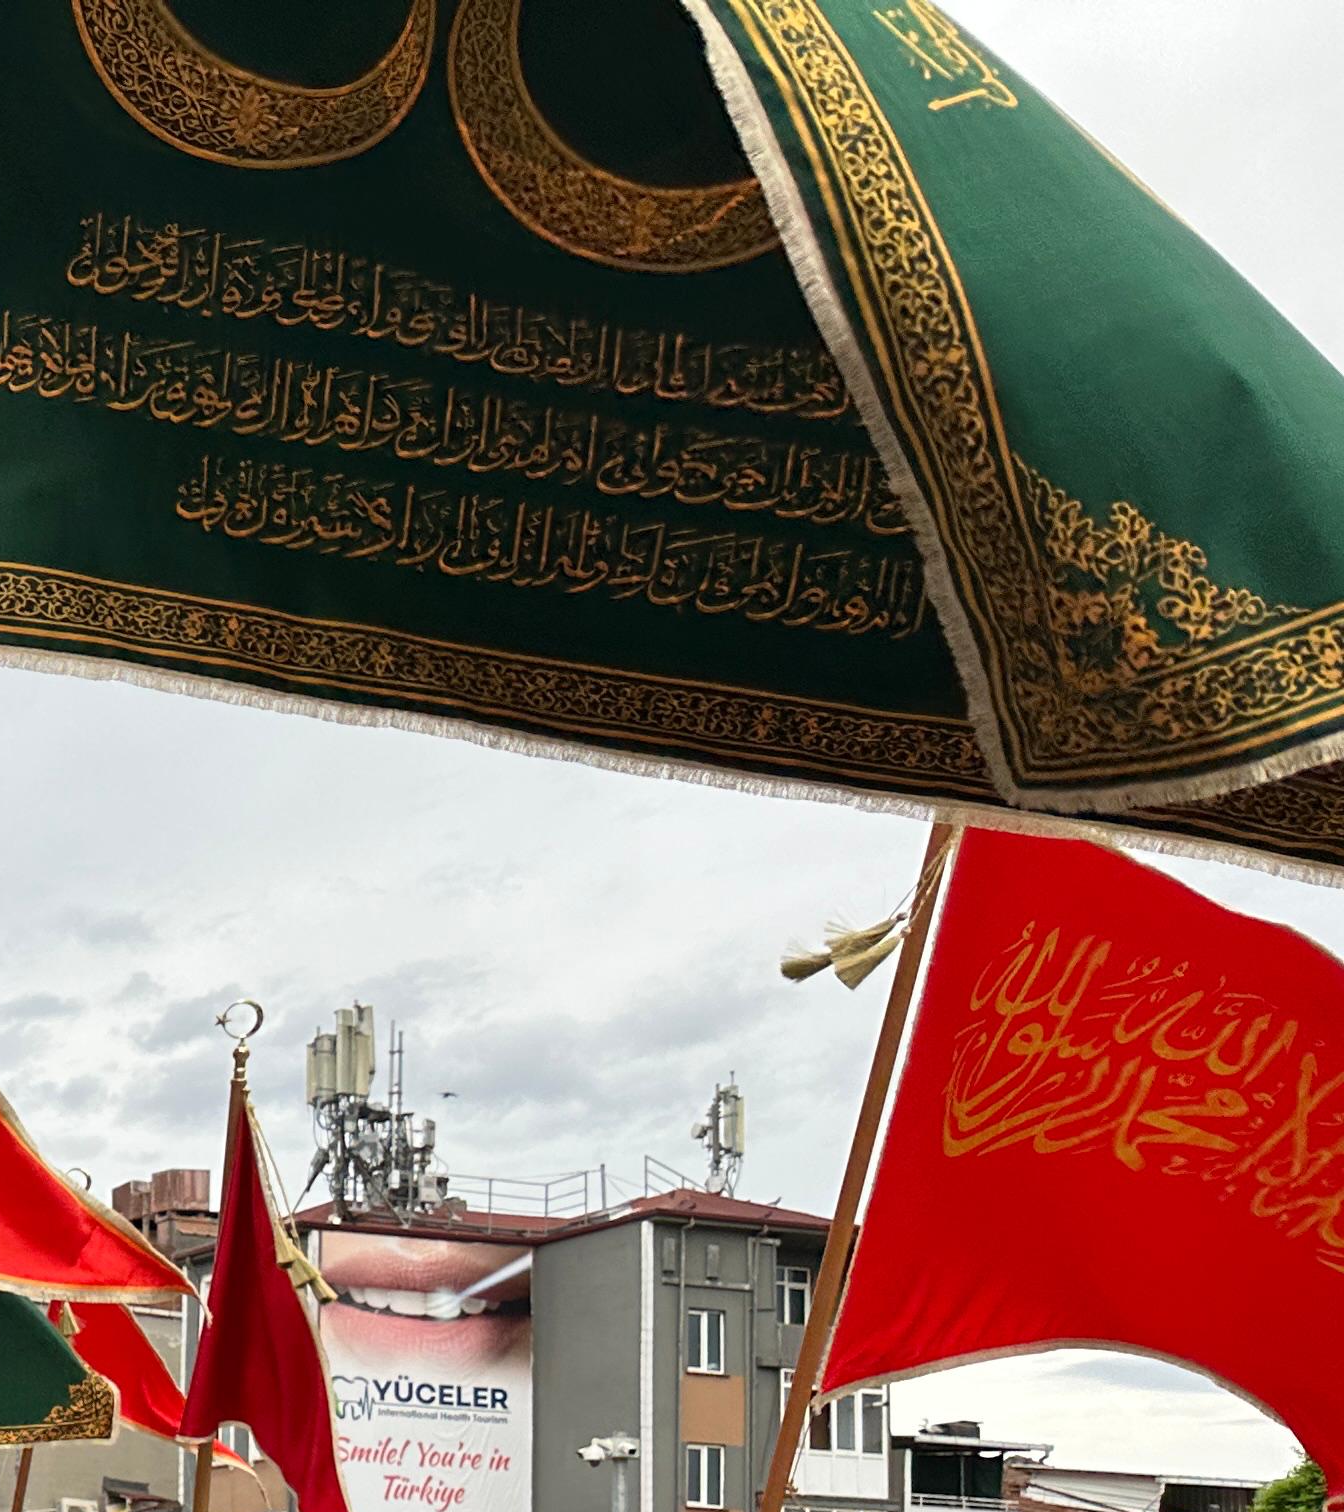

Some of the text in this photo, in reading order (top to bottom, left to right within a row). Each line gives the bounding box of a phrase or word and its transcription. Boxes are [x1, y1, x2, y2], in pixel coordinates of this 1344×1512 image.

[373, 1375, 508, 1410] YÜCELER
[377, 1408, 508, 1424] International Health Tourism
[336, 1437, 410, 1466] Smile!
[489, 1448, 511, 1471] in
